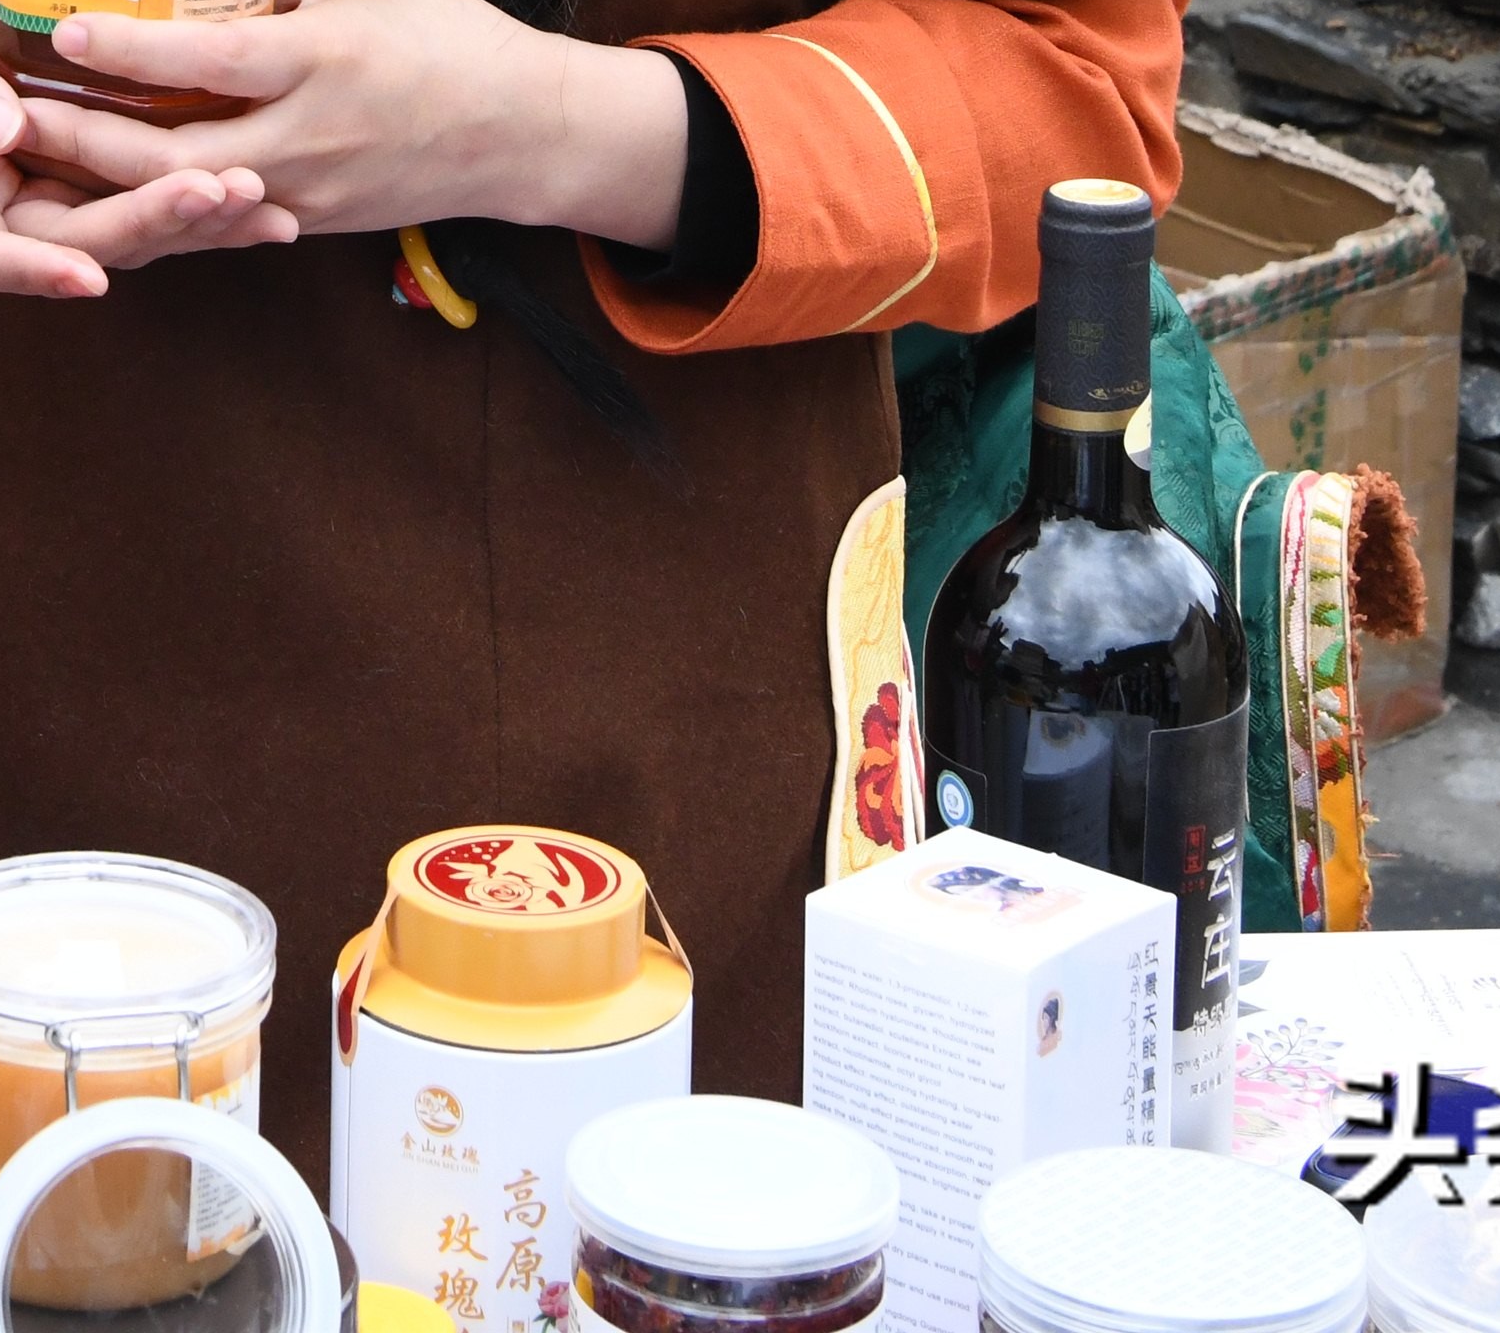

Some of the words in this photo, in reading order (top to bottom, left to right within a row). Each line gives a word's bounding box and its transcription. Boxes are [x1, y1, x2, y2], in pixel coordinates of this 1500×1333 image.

[1201, 827, 1237, 990] 云庄
[849, 981, 883, 1001] Rhodiola
[949, 1016, 996, 1038] hydrolyzed
[850, 999, 878, 1015] sodium
[932, 1027, 969, 1046] Rhodiola
[970, 1040, 996, 1055] rosea
[813, 1049, 842, 1069] Product
[894, 1114, 941, 1137] penetration
[900, 1100, 948, 1124] outstanding
[949, 1118, 974, 1131] water
[401, 1131, 480, 1166] 金山玫瑰
[812, 1099, 832, 1114] make
[834, 1107, 846, 1119] the
[848, 1113, 864, 1126] skin
[944, 1148, 975, 1166] smooth
[977, 1159, 994, 1172] and
[886, 1145, 921, 1164] moisture
[496, 1168, 547, 1293] 高原
[920, 1207, 938, 1219] take
[948, 1217, 976, 1232] proper
[915, 1222, 937, 1236] apply
[947, 1233, 975, 1250] evenly
[434, 1212, 489, 1333] 玫瑰
[934, 1261, 956, 1275] avoid
[886, 1275, 906, 1289] mber
[909, 1284, 924, 1296] and
